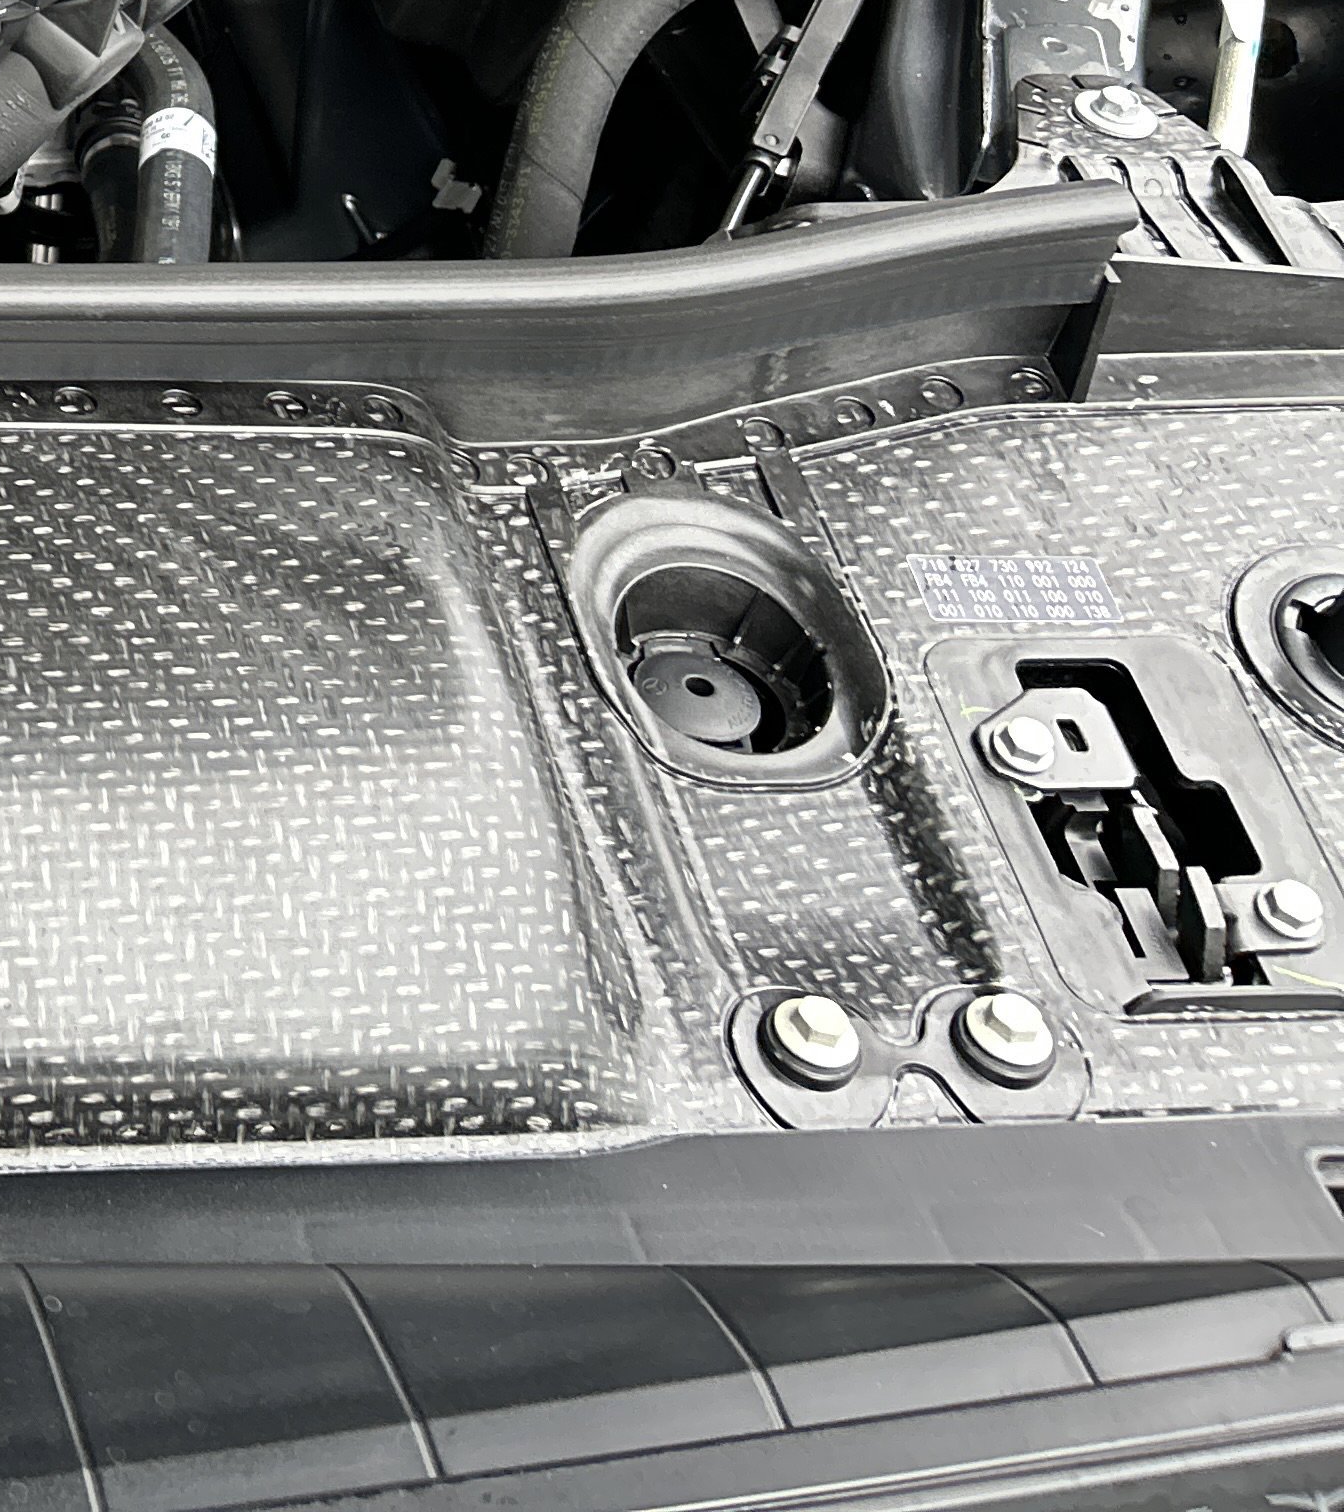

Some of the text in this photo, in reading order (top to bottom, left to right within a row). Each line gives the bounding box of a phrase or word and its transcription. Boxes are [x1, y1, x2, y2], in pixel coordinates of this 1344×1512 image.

[989, 560, 1017, 573] 730
[1026, 560, 1054, 573] 992
[1062, 560, 1089, 573] 124
[998, 575, 1025, 587] 110
[1033, 575, 1059, 588] 001
[1068, 575, 1096, 588] 000
[933, 588, 1103, 603] 111 100 011 100 010
[939, 605, 966, 618] 001
[974, 605, 1002, 618] 010
[1012, 605, 1039, 618] 110
[1047, 605, 1074, 619] 000
